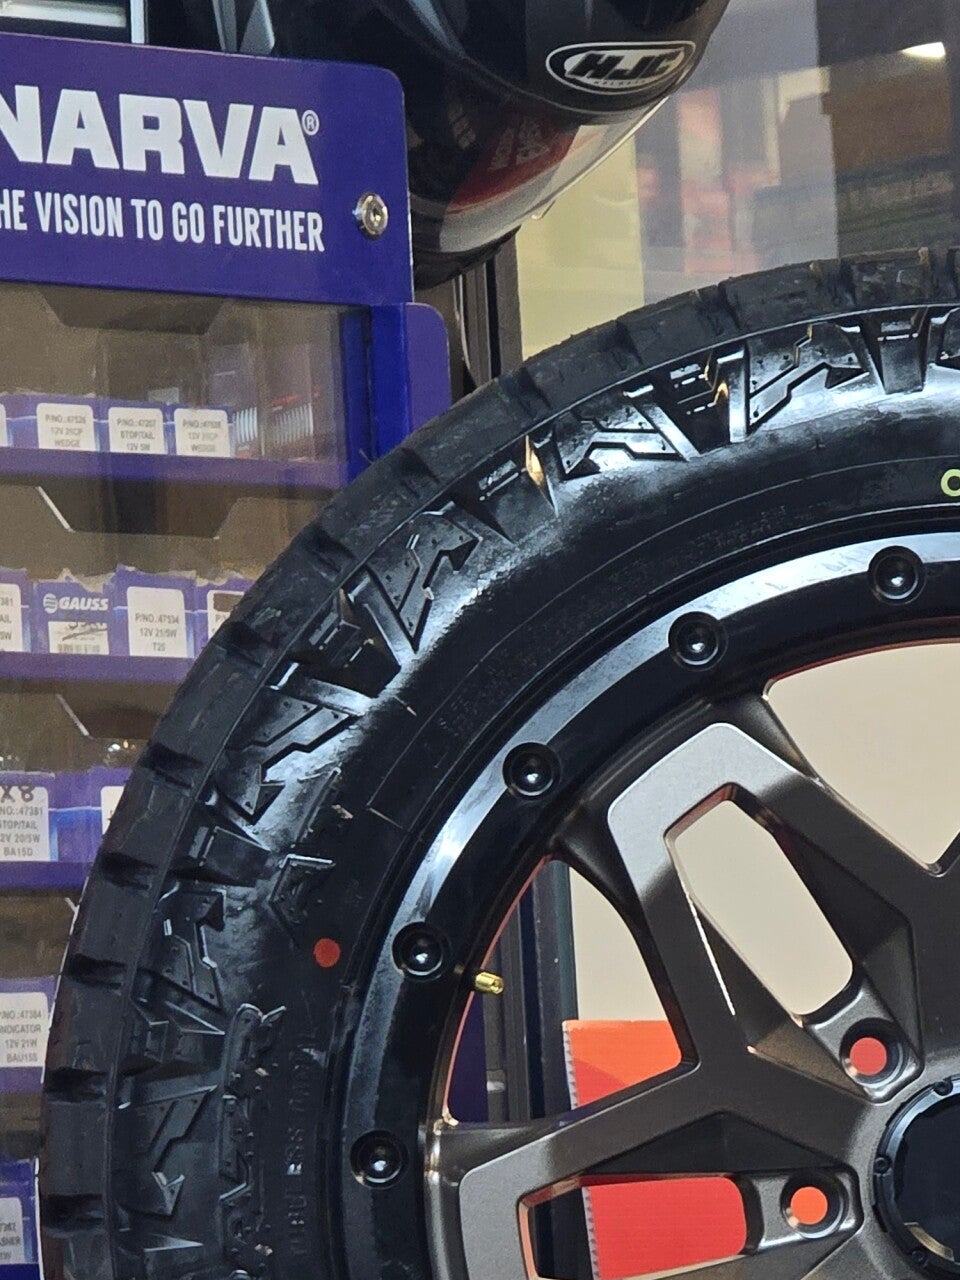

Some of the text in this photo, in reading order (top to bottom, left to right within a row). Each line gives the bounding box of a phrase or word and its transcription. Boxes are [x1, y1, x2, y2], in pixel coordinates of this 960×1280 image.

[569, 51, 684, 80] HJC
[34, 190, 124, 238] VISION
[131, 199, 164, 241] TO
[172, 202, 205, 243] GO
[213, 204, 325, 252] FURTHER
[59, 596, 109, 611] GAUSS
